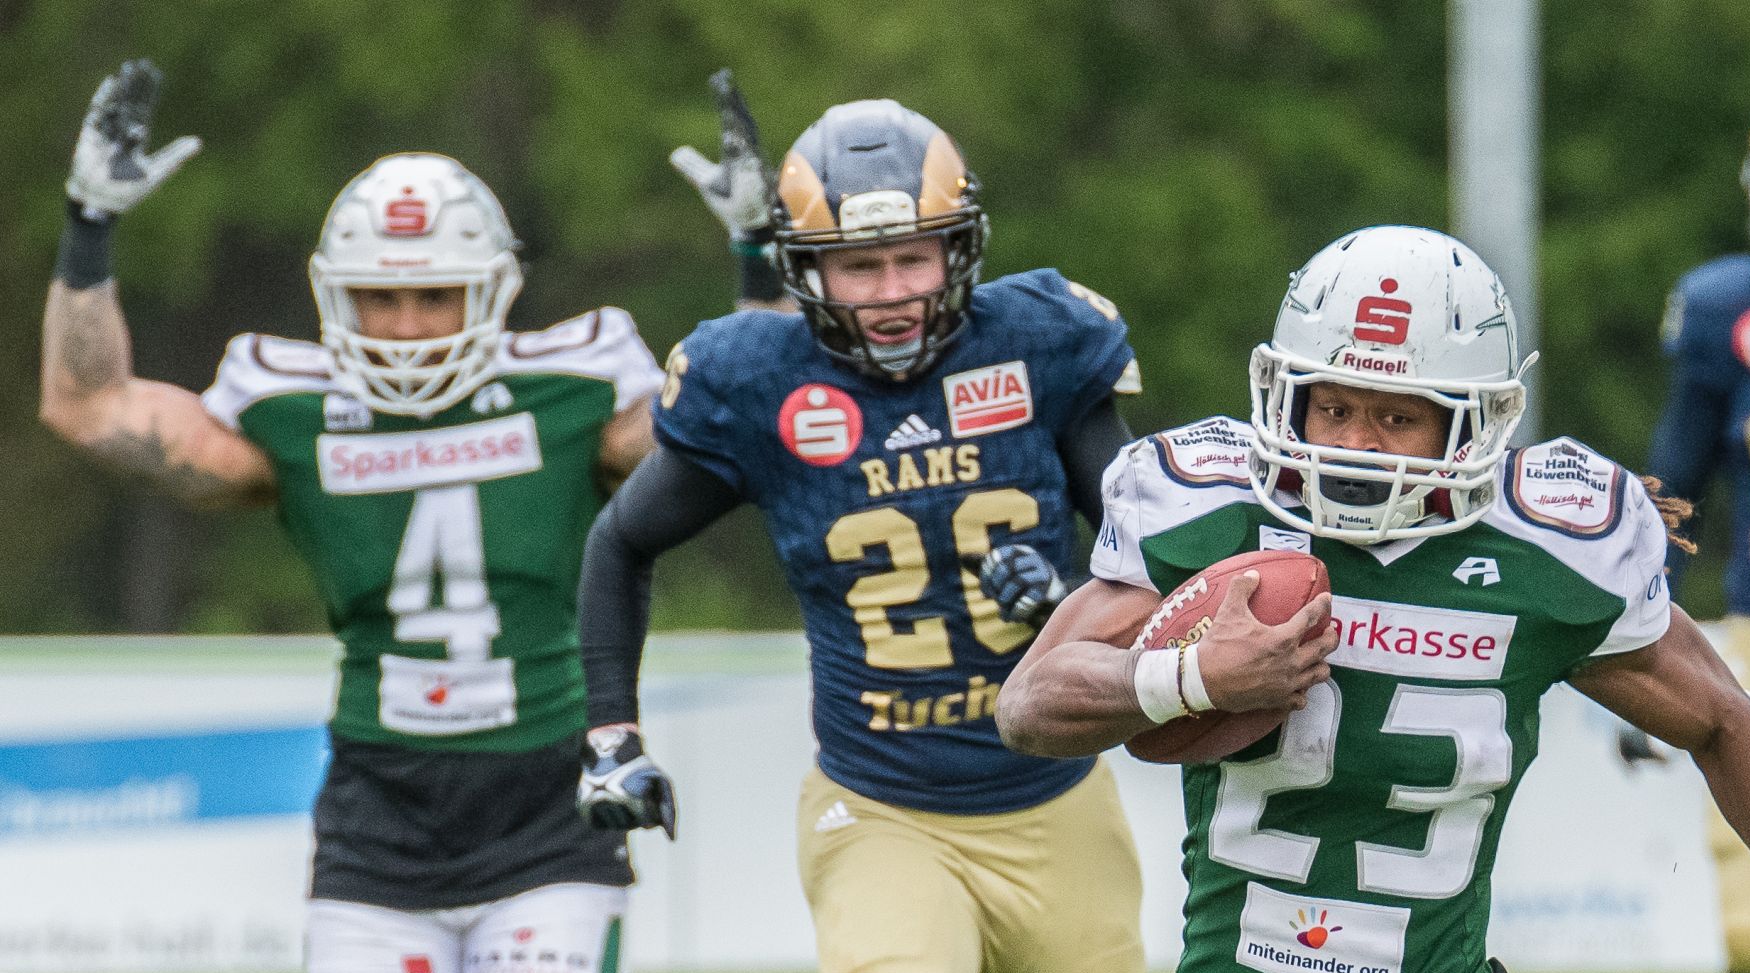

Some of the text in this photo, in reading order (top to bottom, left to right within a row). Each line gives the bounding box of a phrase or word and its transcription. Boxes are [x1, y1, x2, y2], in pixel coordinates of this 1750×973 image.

[1343, 353, 1408, 374] Riddell
[953, 368, 1026, 408] AVIA
[329, 430, 526, 481] Sparkasse
[860, 444, 981, 496] RAMS
[1545, 458, 1591, 476] Haller
[1526, 468, 1606, 492] Löwenbräu
[1337, 513, 1373, 525] Riddell
[386, 483, 501, 663] 4
[825, 488, 1039, 670] 26
[1208, 676, 1514, 899] 23
